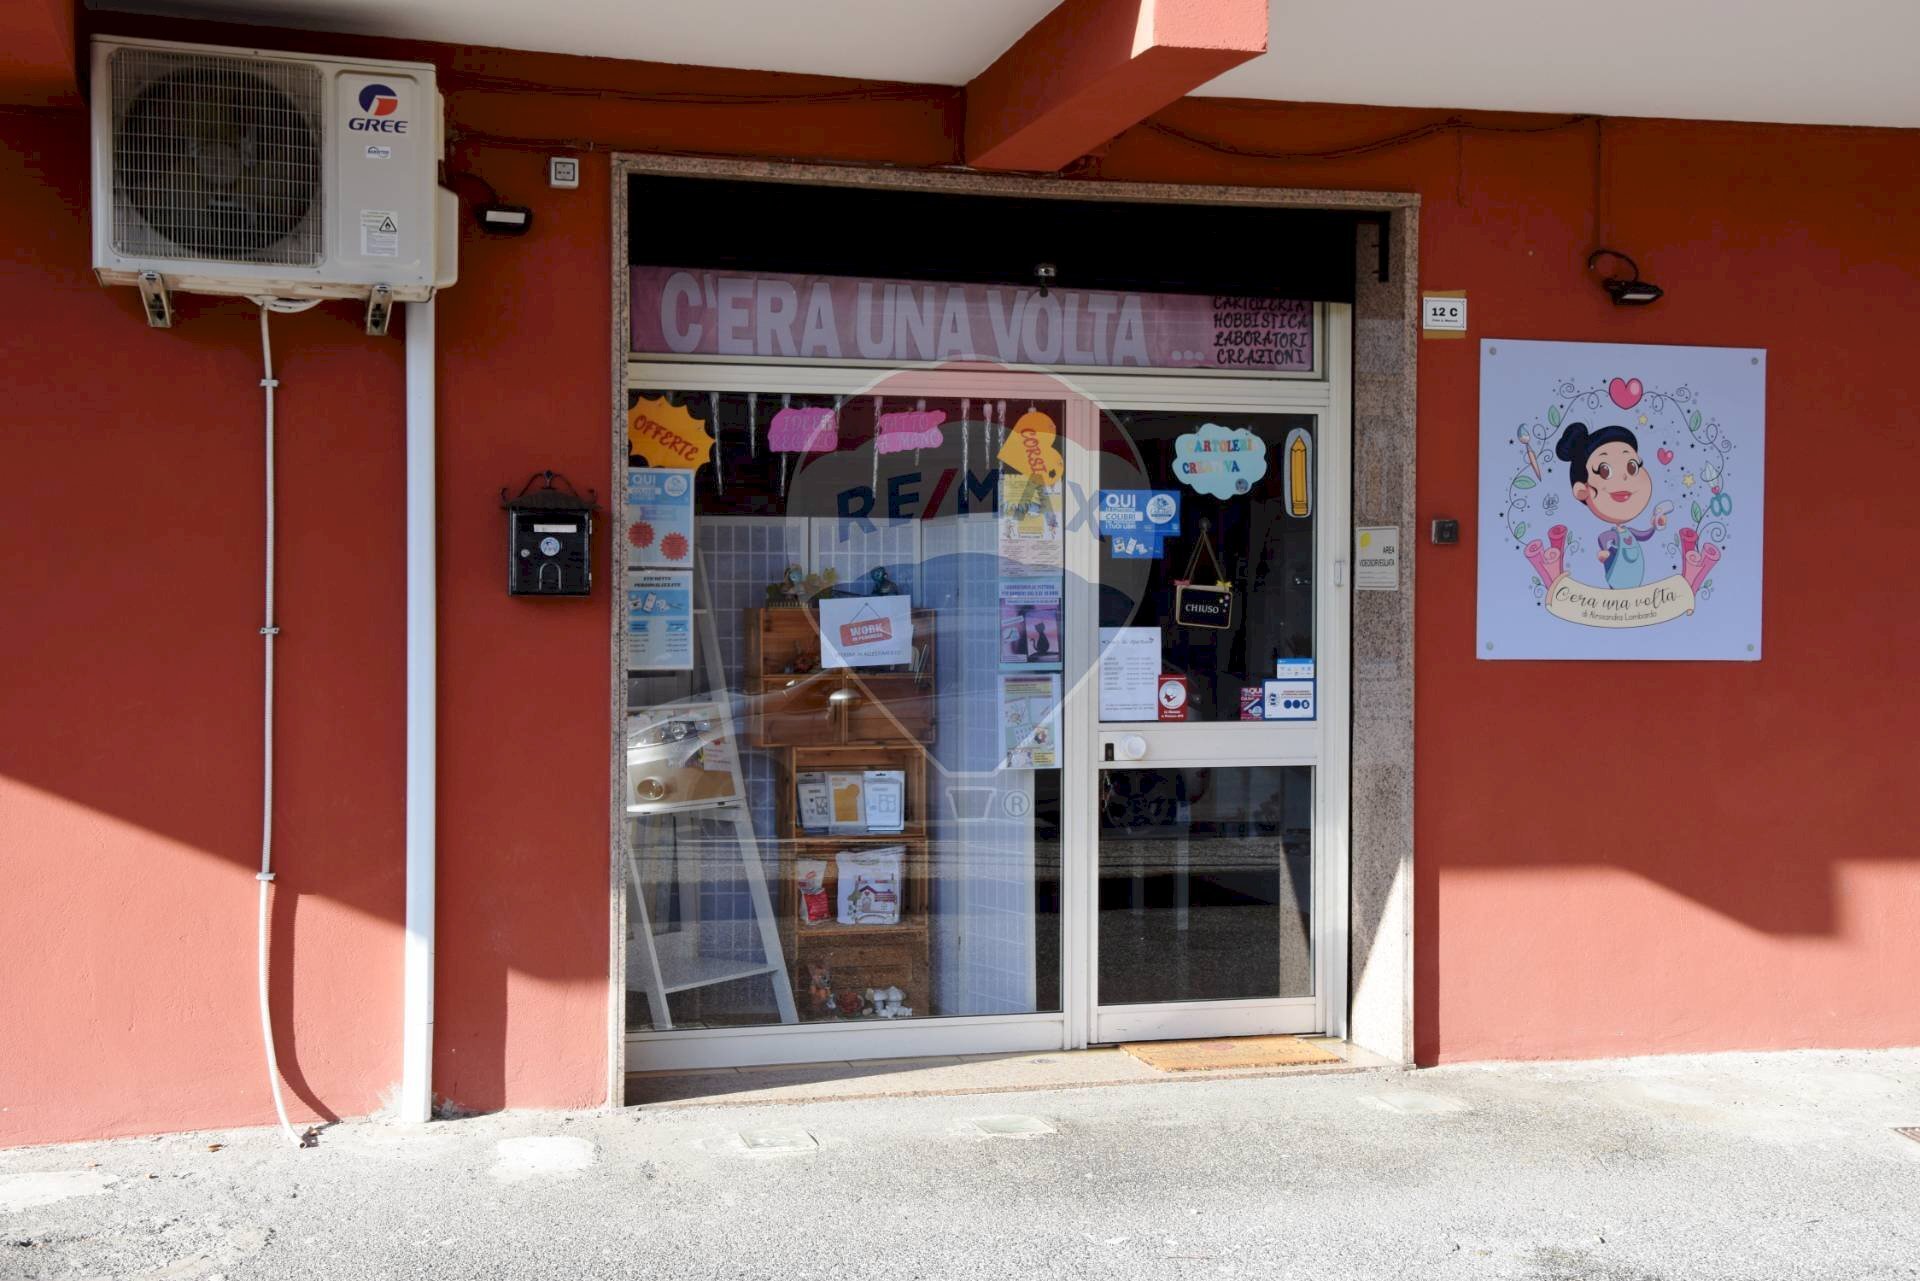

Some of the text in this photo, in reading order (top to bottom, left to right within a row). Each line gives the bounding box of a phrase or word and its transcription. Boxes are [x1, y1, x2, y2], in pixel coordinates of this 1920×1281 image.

[349, 118, 408, 134] GREE
[661, 271, 842, 359] C'ERA
[857, 282, 976, 361] UNA
[987, 289, 1150, 367] VOLTA
[1432, 307, 1458, 317] 12 C
[1213, 311, 1308, 329] HOBBISTICA
[1213, 331, 1308, 348] LABORATORI
[1216, 348, 1305, 365] CREAZIONI
[633, 415, 699, 462] OFFERTE
[1184, 439, 1256, 453] CARTOLERI
[1019, 427, 1048, 477] CORSI
[633, 474, 656, 485] QUI
[1106, 494, 1136, 508] QUI
[1382, 546, 1395, 554] AREA
[1185, 603, 1219, 614] CHIUSO
[1602, 598, 1631, 611] una
[850, 622, 882, 637] WORK
